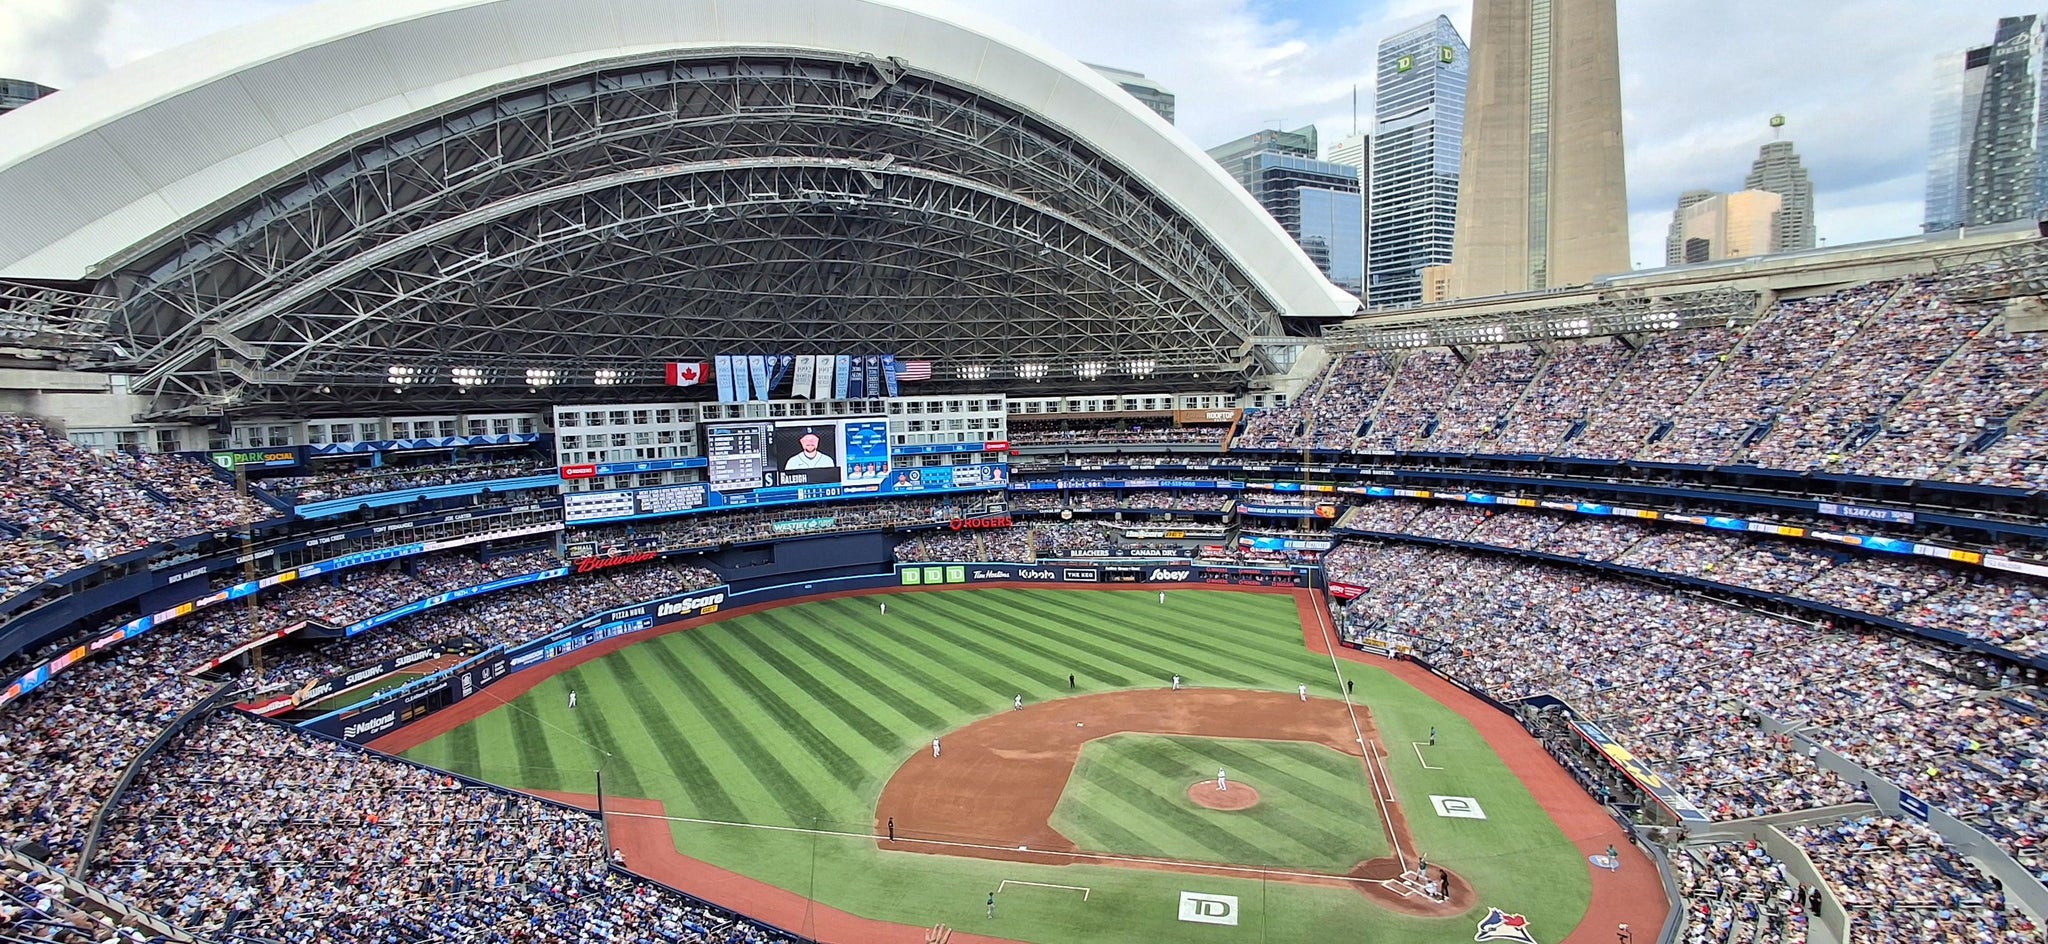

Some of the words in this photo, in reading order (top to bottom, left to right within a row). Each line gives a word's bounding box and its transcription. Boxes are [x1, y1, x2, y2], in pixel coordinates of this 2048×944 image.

[1398, 56, 1411, 69] TD
[214, 455, 232, 468] TD
[234, 453, 264, 462] PARK
[265, 453, 295, 461] SOCIAL
[763, 474, 773, 487] S
[780, 474, 807, 486] RALEIGH
[774, 521, 809, 532] WESTJET
[965, 517, 1011, 528] ROGERS
[1131, 549, 1160, 557] CANADA
[574, 552, 657, 574] Budweiser
[1018, 569, 1056, 580] Kubota
[1150, 569, 1189, 581] Sobeys
[657, 593, 724, 617] theScore
[611, 610, 629, 621] PIZZA
[630, 606, 645, 616] NOVA
[395, 648, 433, 668] SUBWAY
[345, 665, 384, 686] SUBWAY
[355, 711, 396, 736] National
[1442, 799, 1471, 814] TD
[1187, 898, 1231, 917] TD
